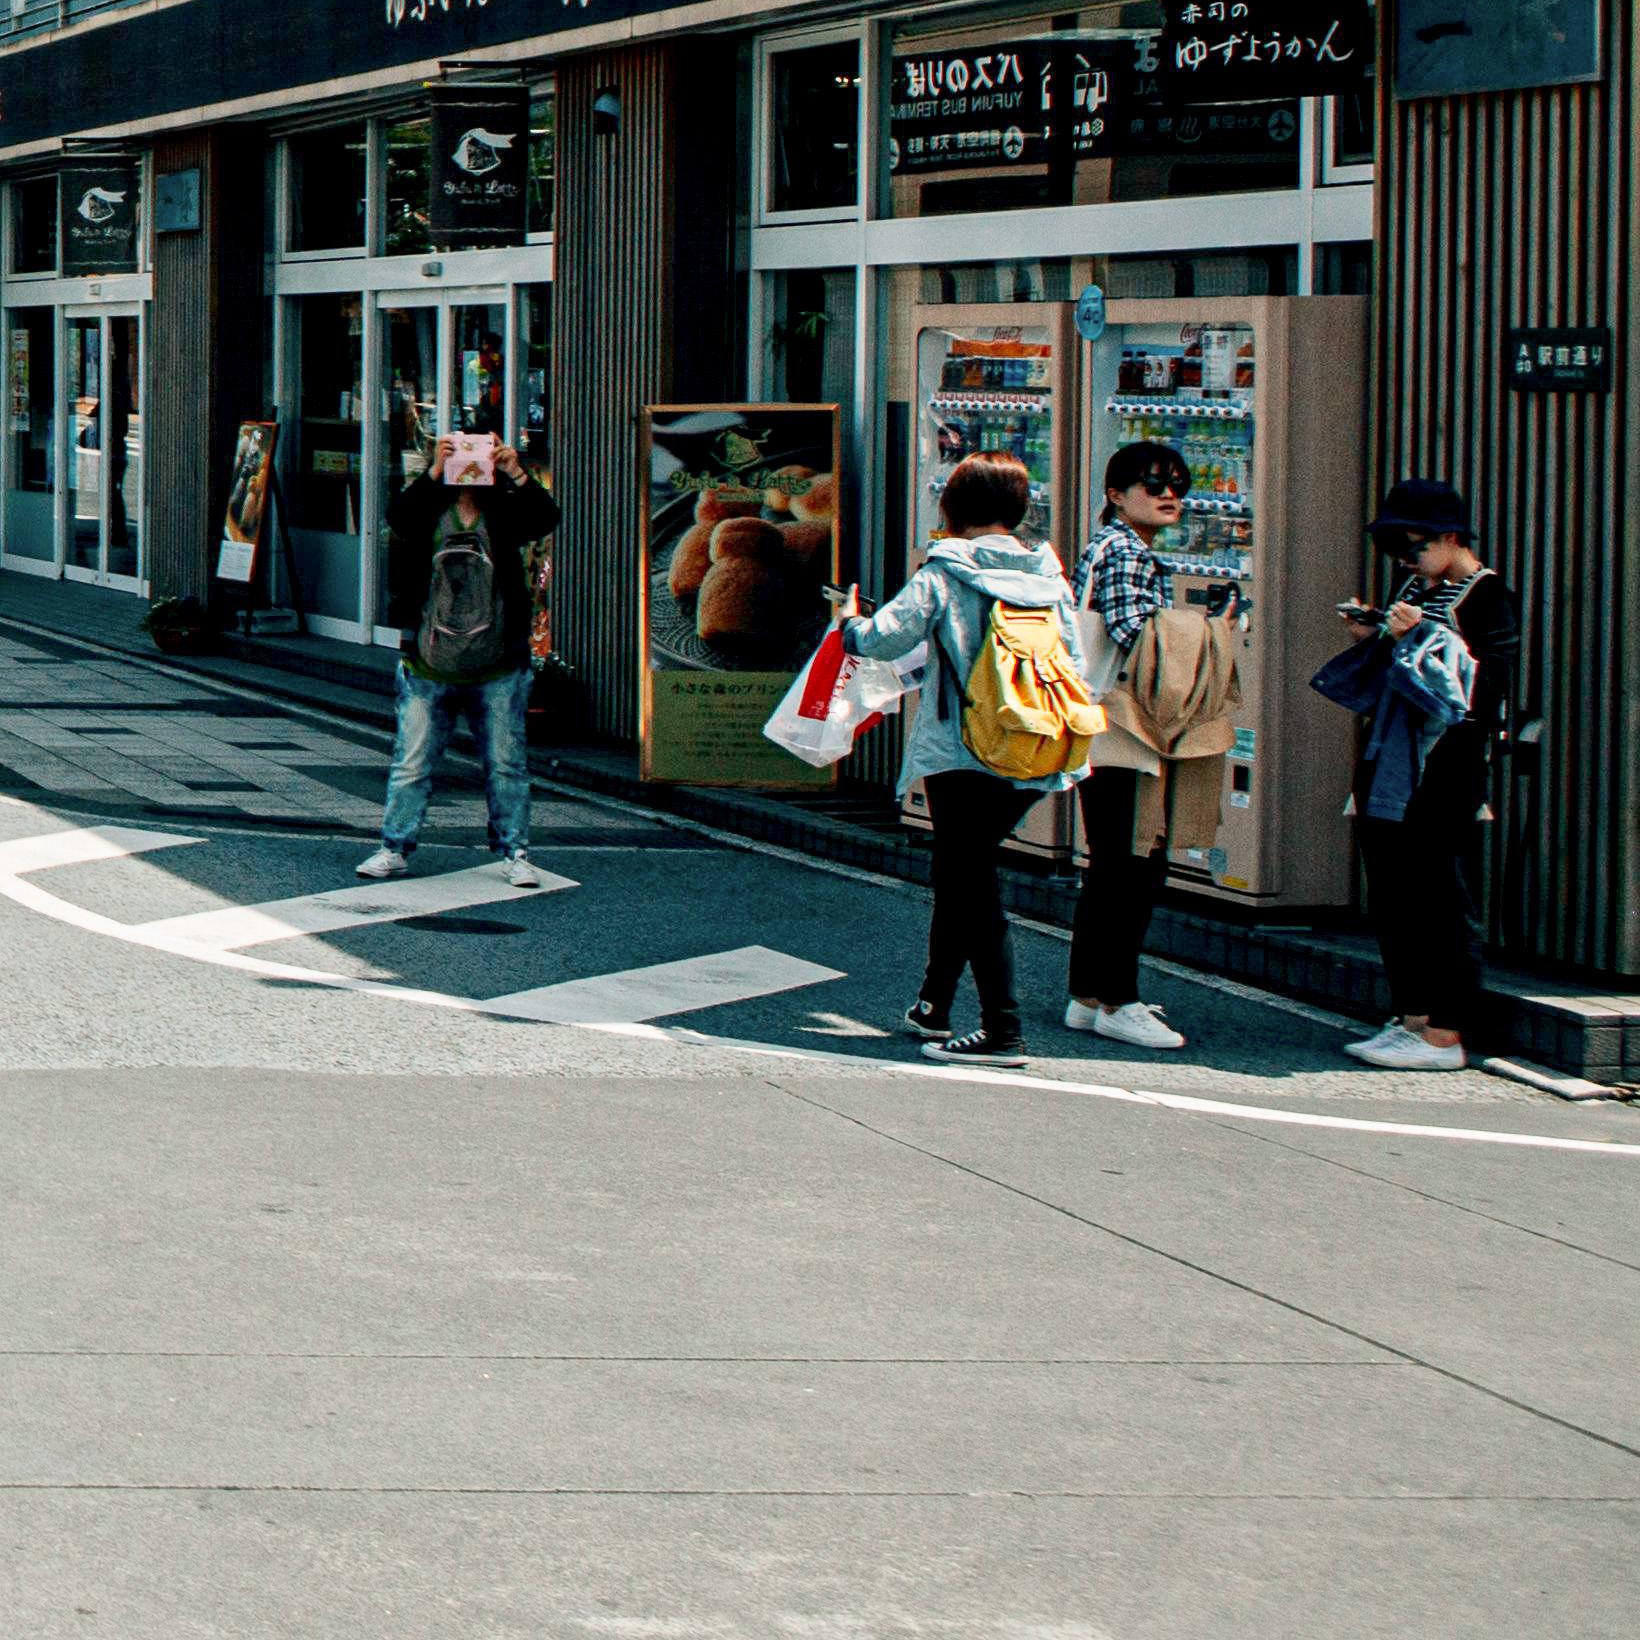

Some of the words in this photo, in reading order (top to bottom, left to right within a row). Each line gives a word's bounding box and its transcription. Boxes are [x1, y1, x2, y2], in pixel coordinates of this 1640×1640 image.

[1175, 20, 1354, 72] ゆずようかん
[1538, 345, 1604, 366] 駅前通り
